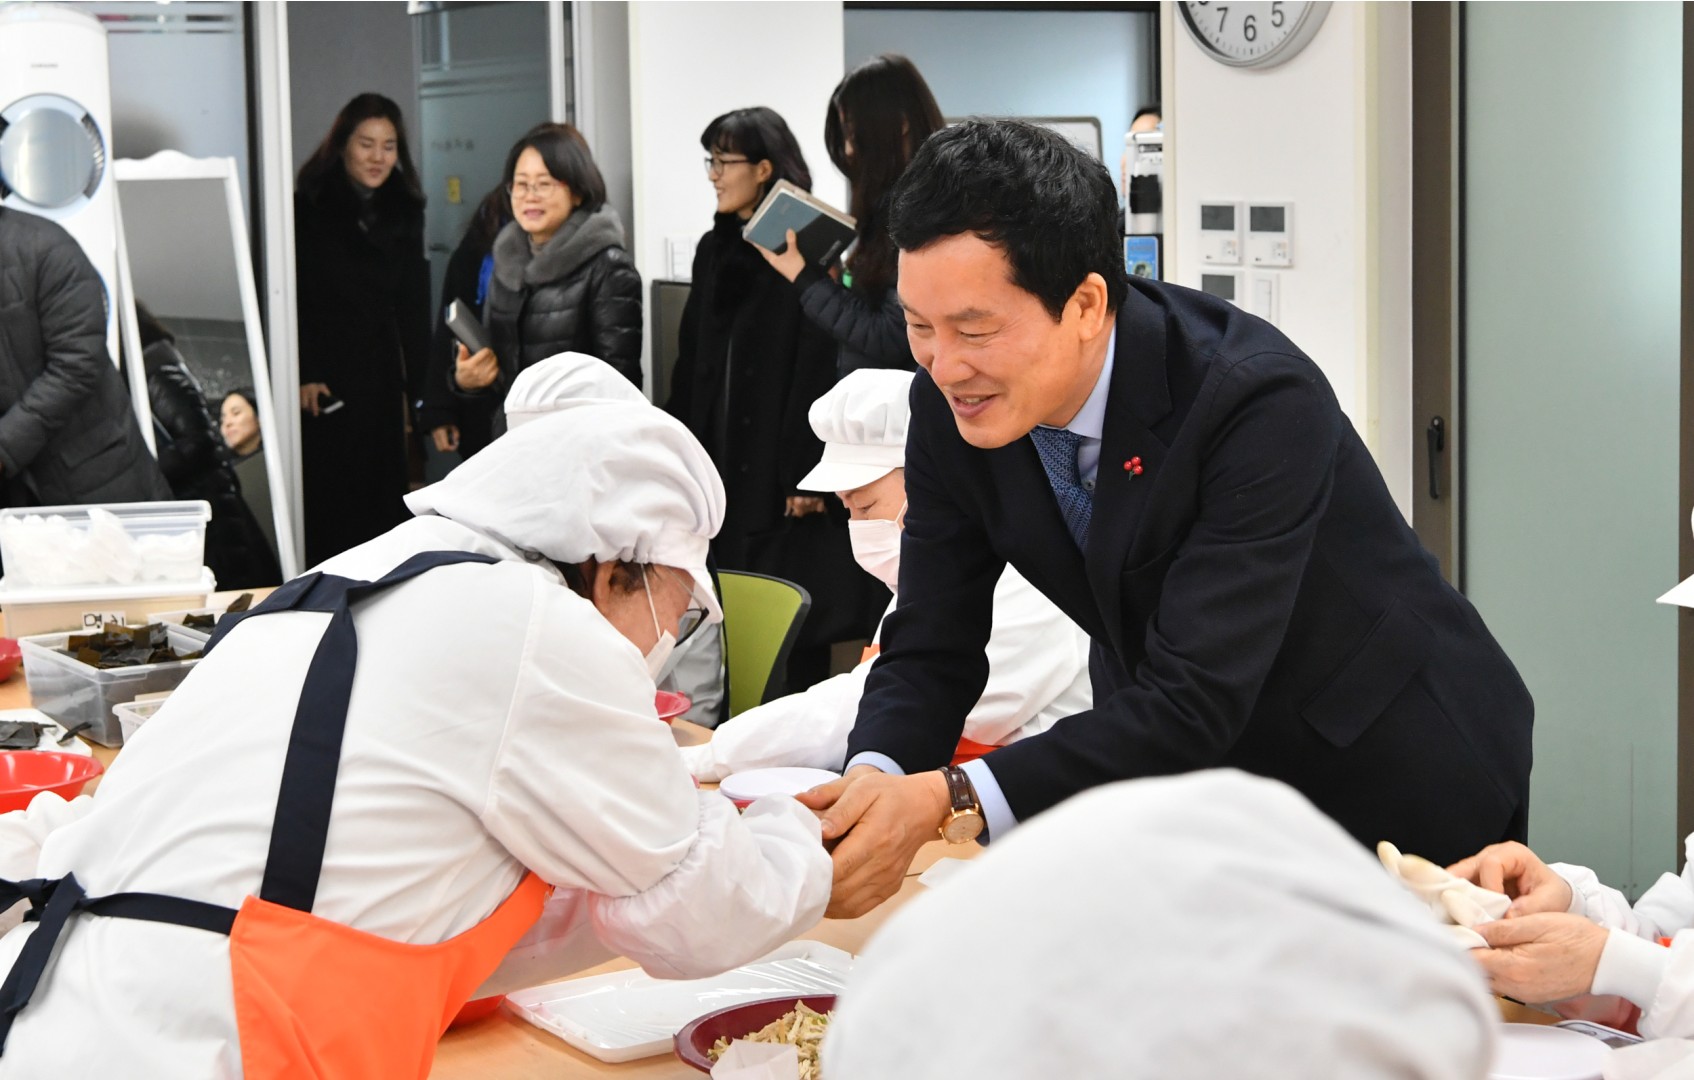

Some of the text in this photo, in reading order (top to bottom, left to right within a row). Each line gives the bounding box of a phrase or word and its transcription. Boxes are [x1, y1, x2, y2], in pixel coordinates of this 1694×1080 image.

[1216, 6, 1229, 33] 7
[1243, 14, 1257, 42] 6
[1271, 1, 1285, 28] 5
